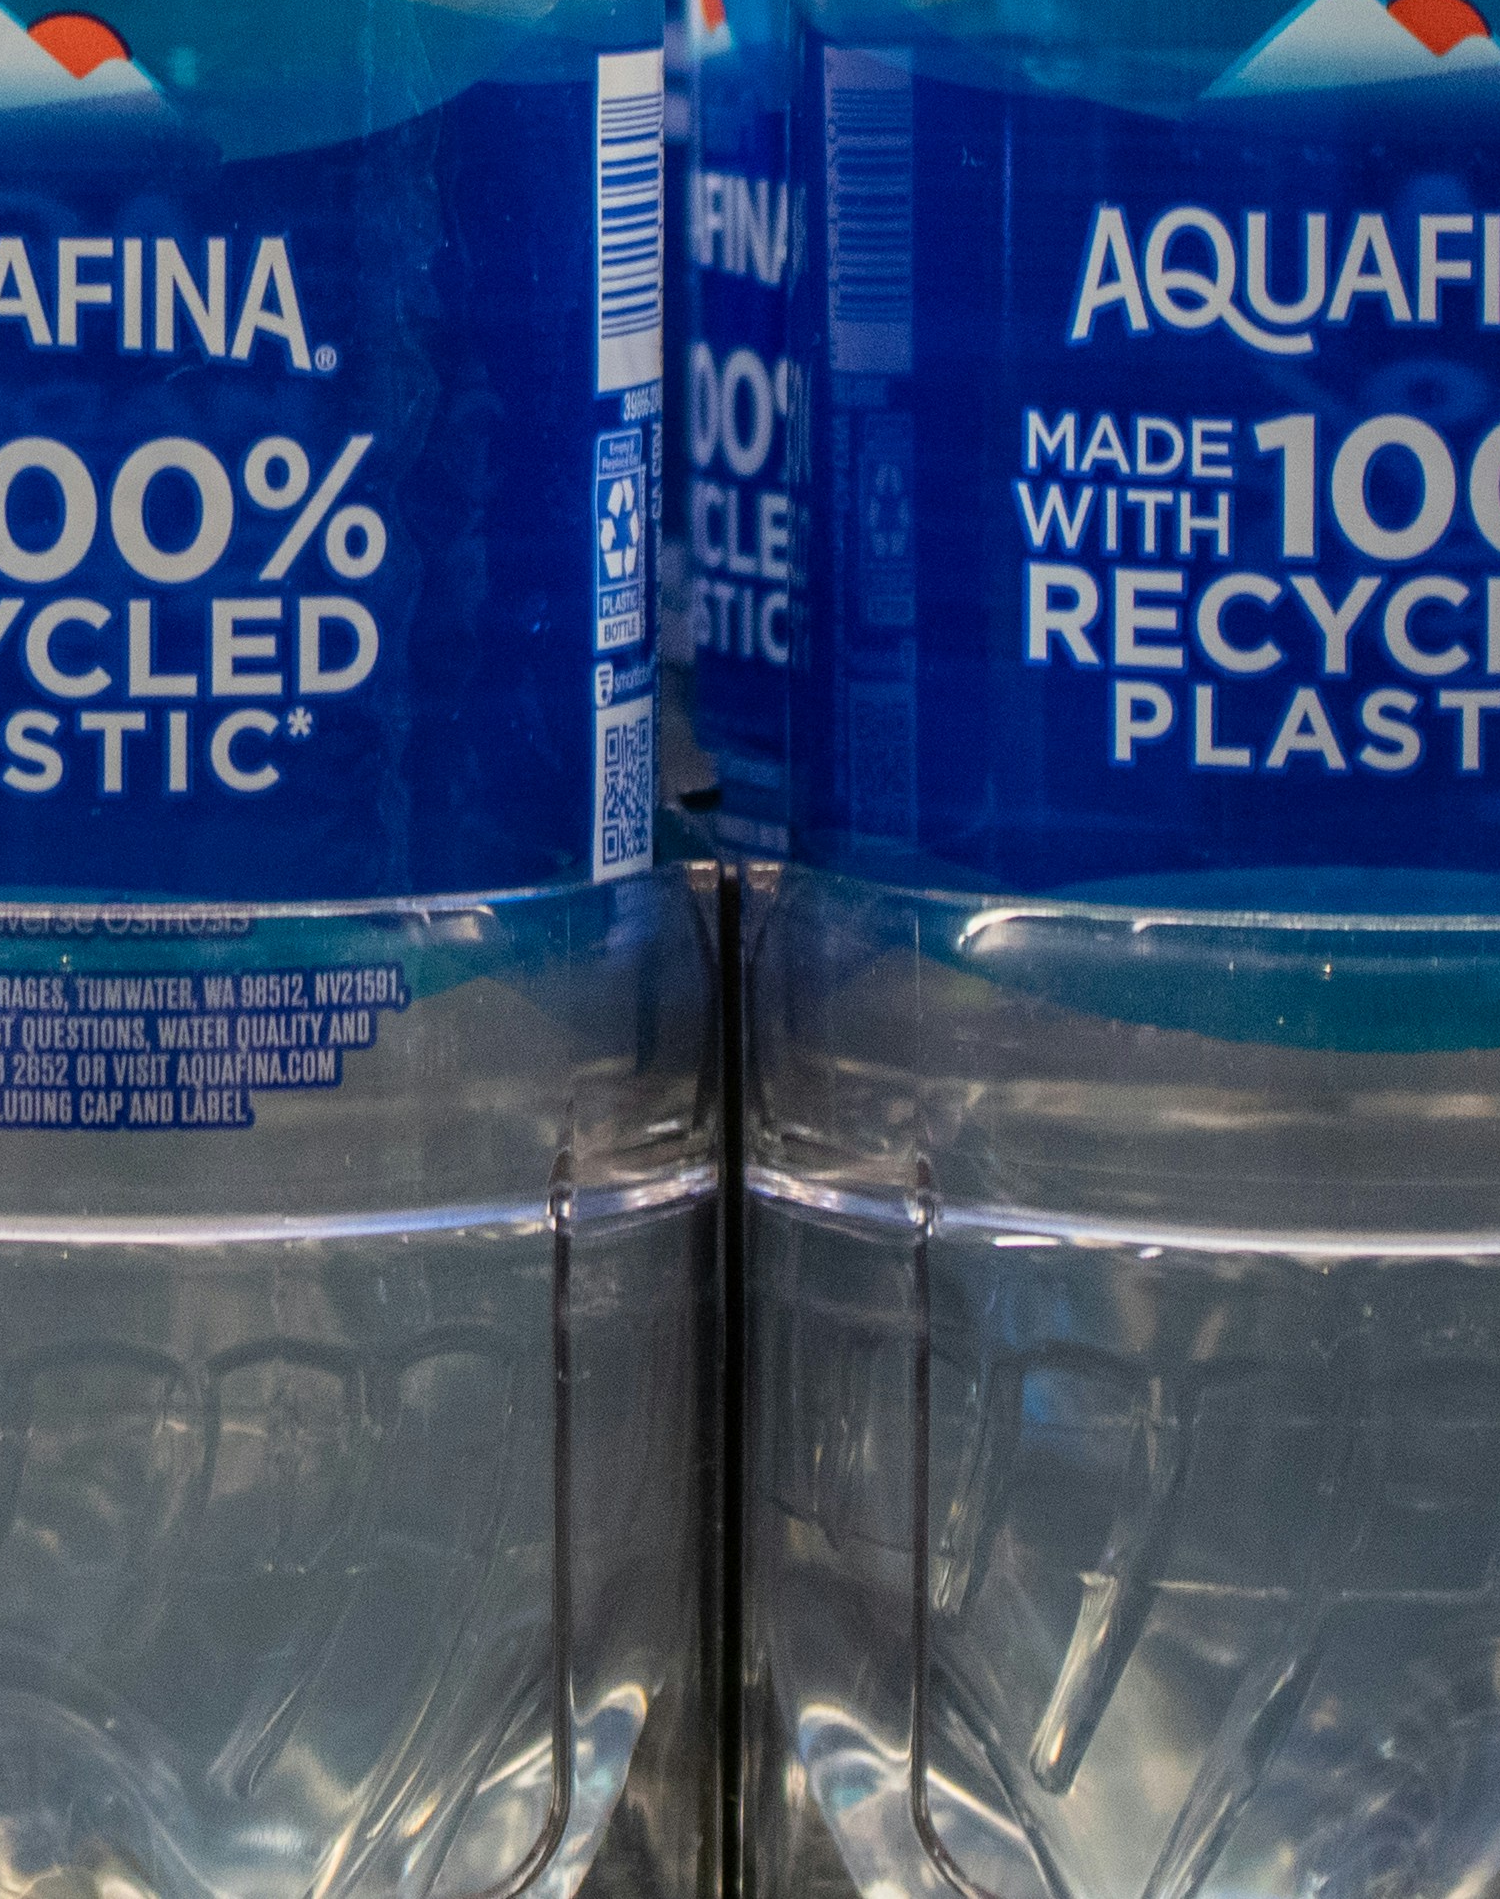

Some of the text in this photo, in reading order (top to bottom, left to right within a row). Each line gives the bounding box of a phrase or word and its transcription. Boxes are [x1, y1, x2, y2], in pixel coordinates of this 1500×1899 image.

[1028, 411, 1233, 478] MADE
[1018, 483, 1230, 555] WITH
[603, 616, 638, 643] BOTTLE
[203, 977, 236, 1009] WA
[241, 974, 309, 1008] 98512,
[22, 1016, 150, 1052] QUESTIONS,
[157, 1017, 229, 1049] WATER
[236, 1012, 325, 1054] QUALITY
[329, 1010, 371, 1045] AND
[13, 1053, 69, 1088] 2652
[76, 1054, 107, 1088] OR
[113, 1054, 171, 1087] VISIT
[176, 1050, 337, 1091] AQUAFINA.COM
[80, 1091, 124, 1124] CAP
[129, 1091, 175, 1124] AND
[182, 1089, 248, 1124] LABEL
